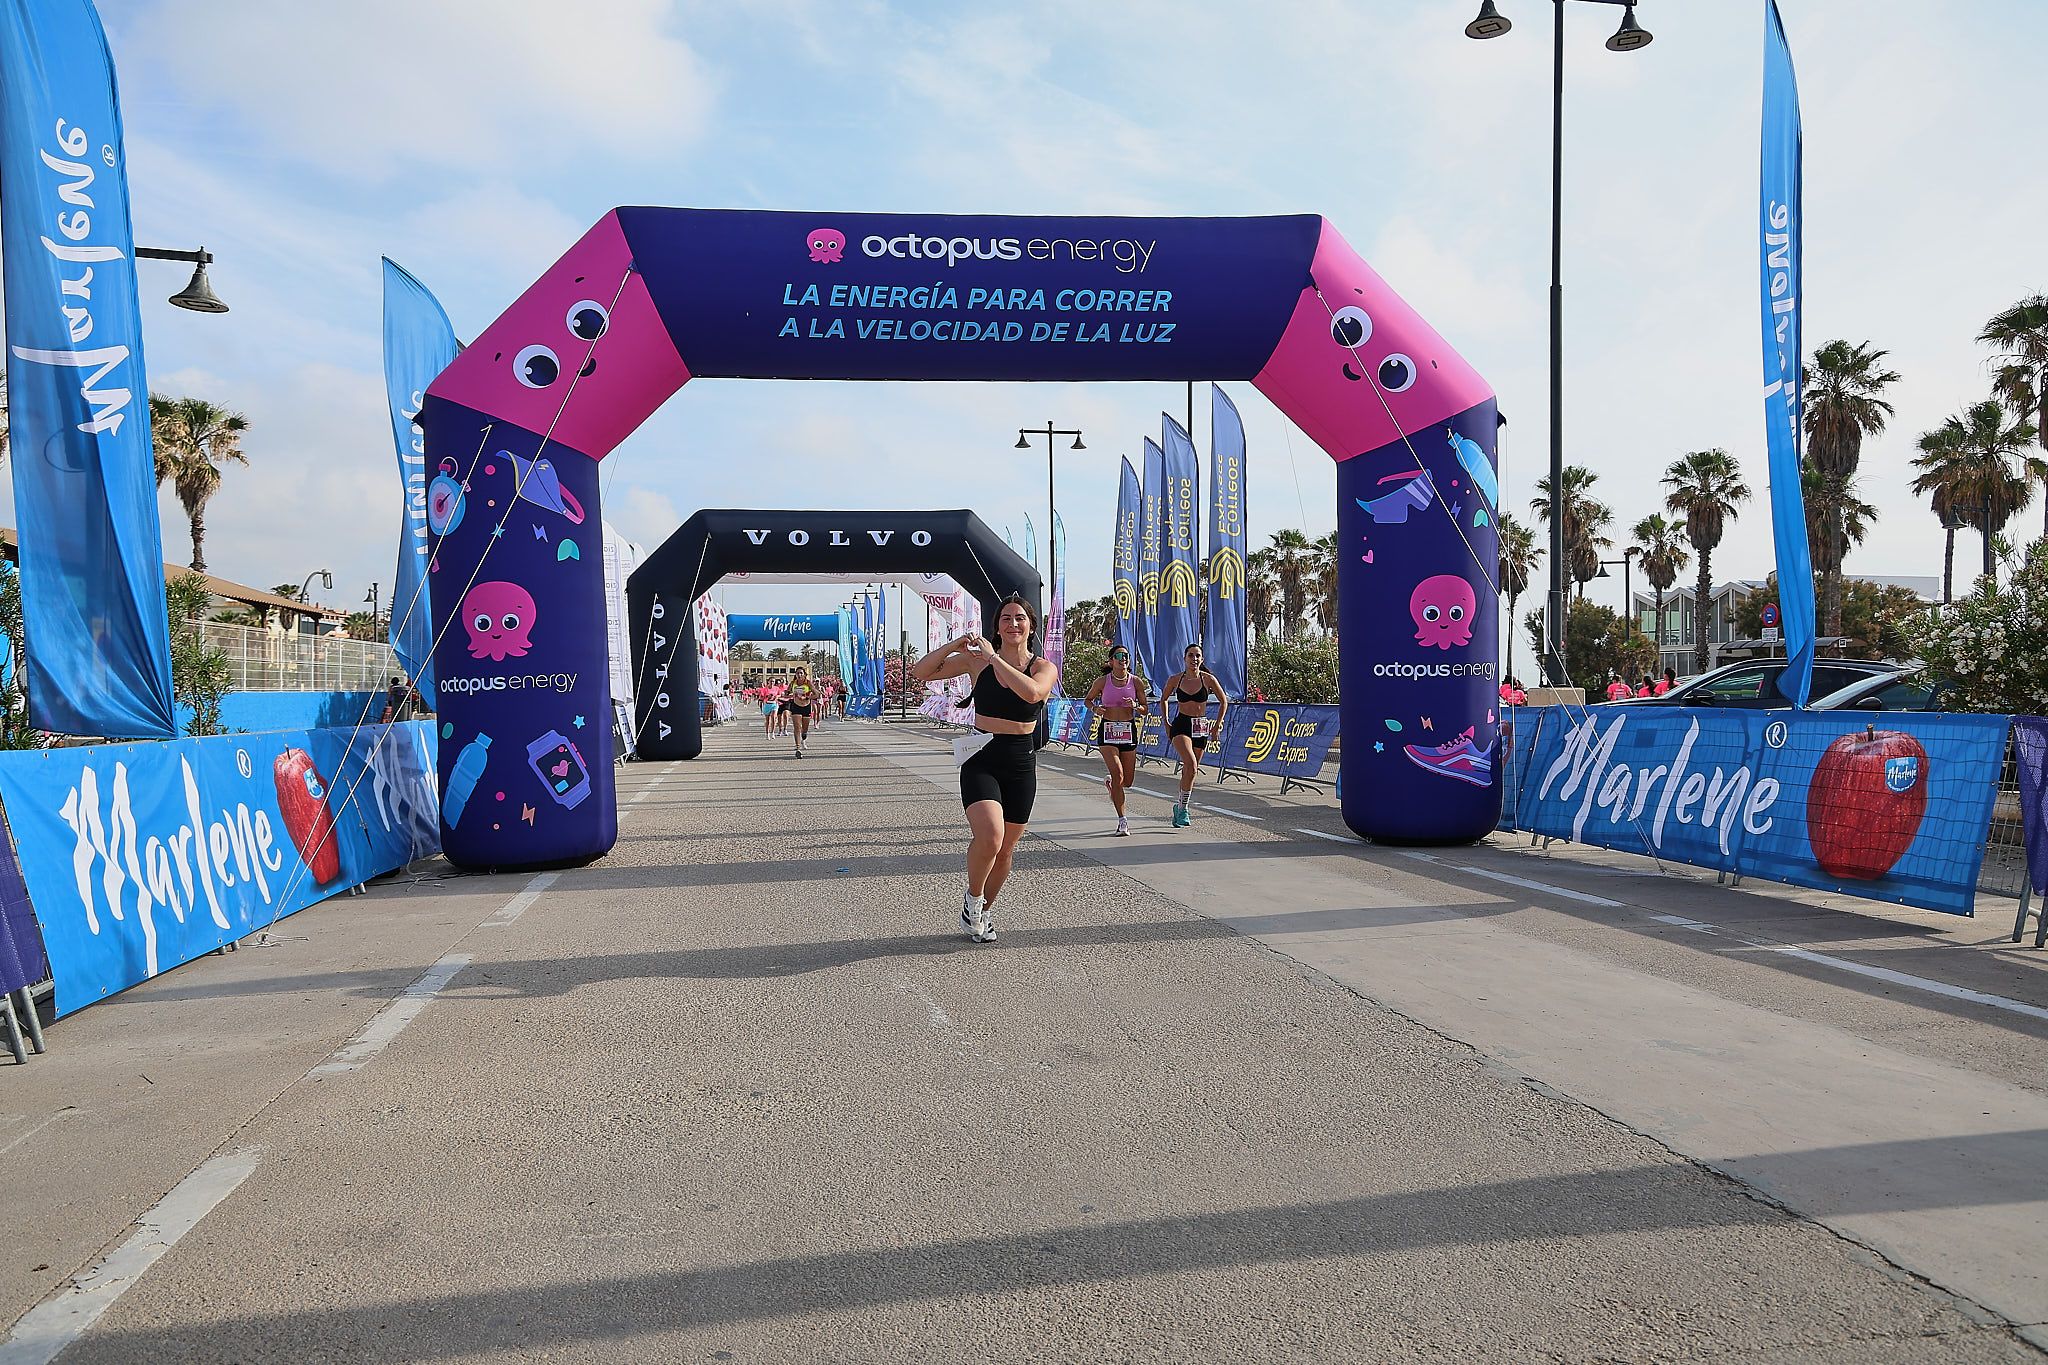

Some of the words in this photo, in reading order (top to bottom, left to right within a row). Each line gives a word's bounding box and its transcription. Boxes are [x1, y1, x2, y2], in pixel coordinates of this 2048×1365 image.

[861, 232, 1023, 267] octopus
[1027, 239, 1157, 273] energy
[782, 282, 821, 306] LA
[828, 281, 959, 309] ENERGÍA
[967, 287, 1046, 311] PARA
[1055, 289, 1173, 312] CORRER
[778, 317, 800, 338] A
[808, 318, 846, 339] LA
[856, 319, 1024, 342] VELOCIDAD
[1030, 321, 1069, 342] DE
[1075, 322, 1111, 342] LA
[1118, 322, 1177, 343] LUZ
[742, 529, 932, 547] VOLVO
[763, 617, 811, 638] Marlene
[440, 676, 507, 696] octopus
[508, 673, 578, 693] energy
[653, 603, 673, 741] VOLVO
[1373, 661, 1451, 681] octopus
[1452, 662, 1497, 681] energy
[1539, 713, 1781, 856] Marlene
[59, 752, 282, 979] Marlene
